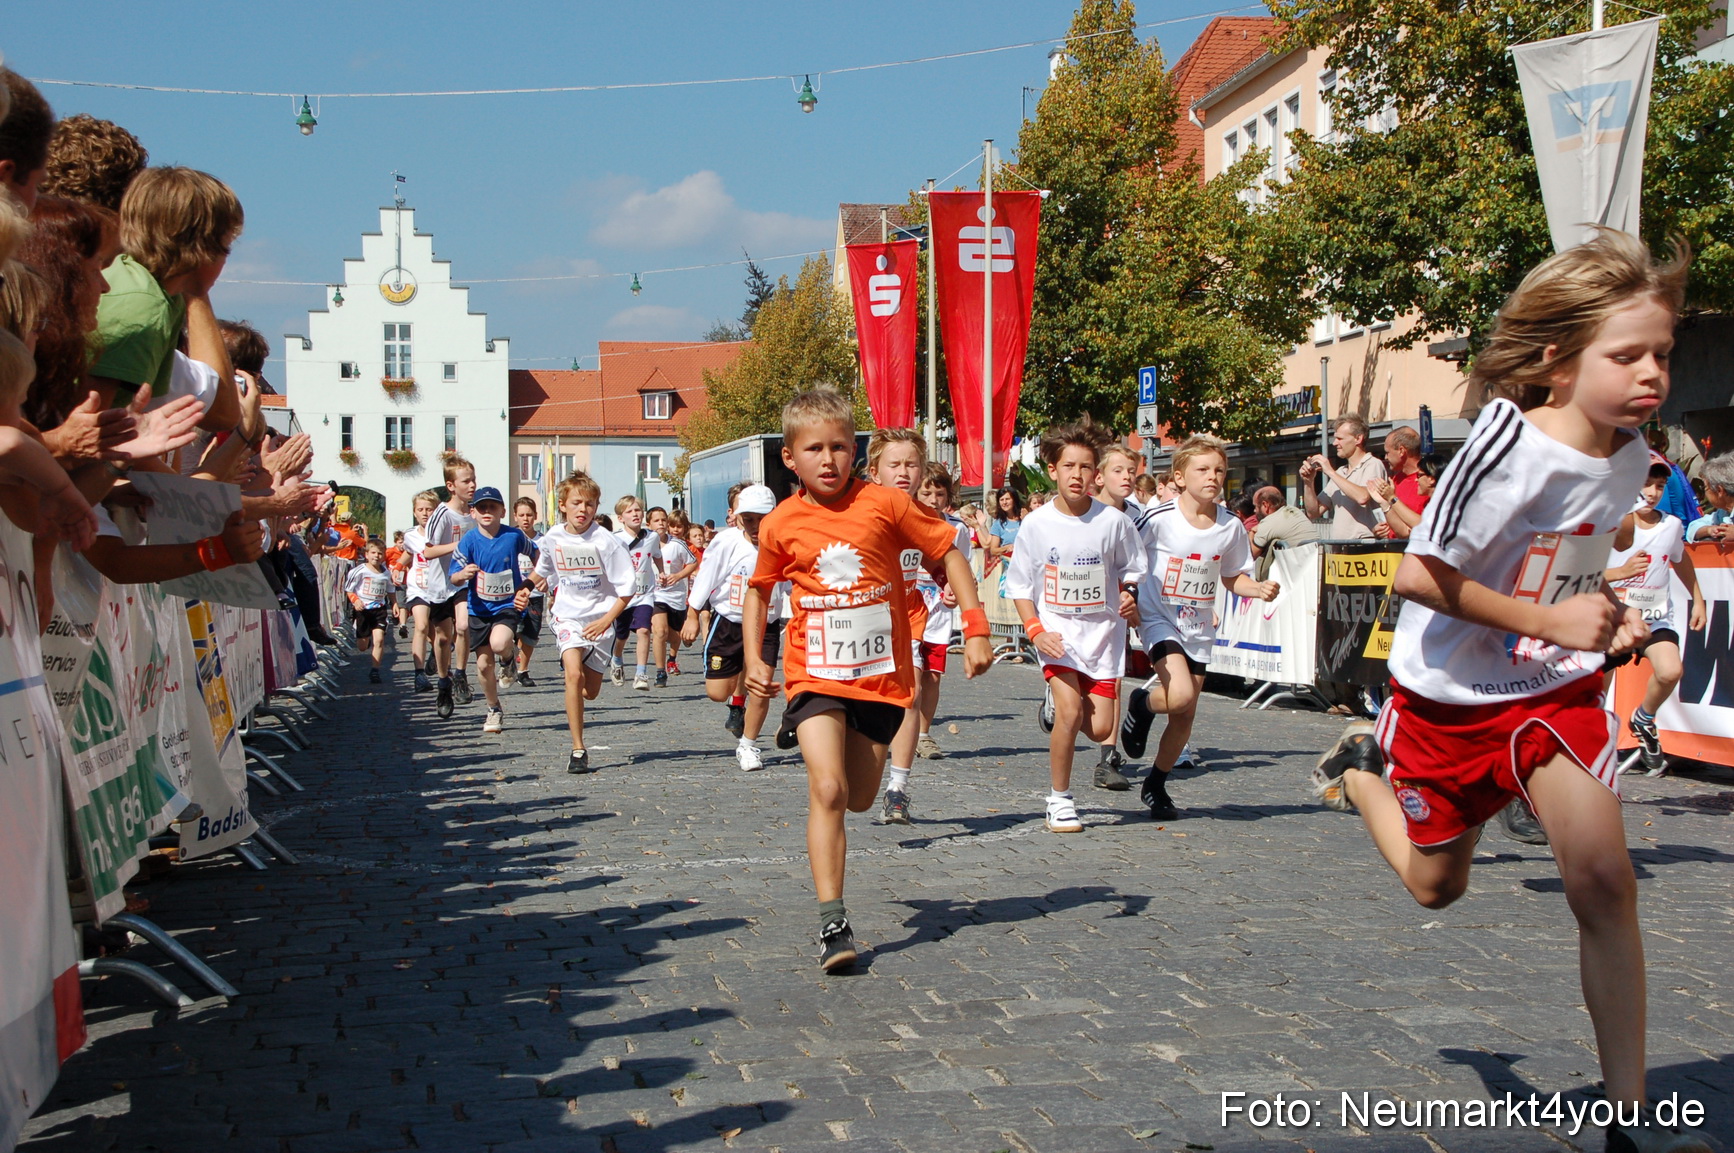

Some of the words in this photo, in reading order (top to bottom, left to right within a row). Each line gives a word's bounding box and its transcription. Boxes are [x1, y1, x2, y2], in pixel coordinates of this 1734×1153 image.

[566, 556, 596, 567] 7170
[902, 552, 920, 567] 05
[1184, 564, 1209, 575] Stefan
[1060, 571, 1091, 581] Michael
[486, 583, 511, 594] 7216
[1061, 586, 1101, 601] 7155
[1182, 580, 1215, 595] 7102
[800, 594, 851, 609] MERZ
[852, 582, 892, 606] Reisen
[1628, 592, 1655, 602] Michael
[828, 616, 852, 629] Tom
[809, 636, 821, 646] K4
[832, 635, 886, 660] 7118
